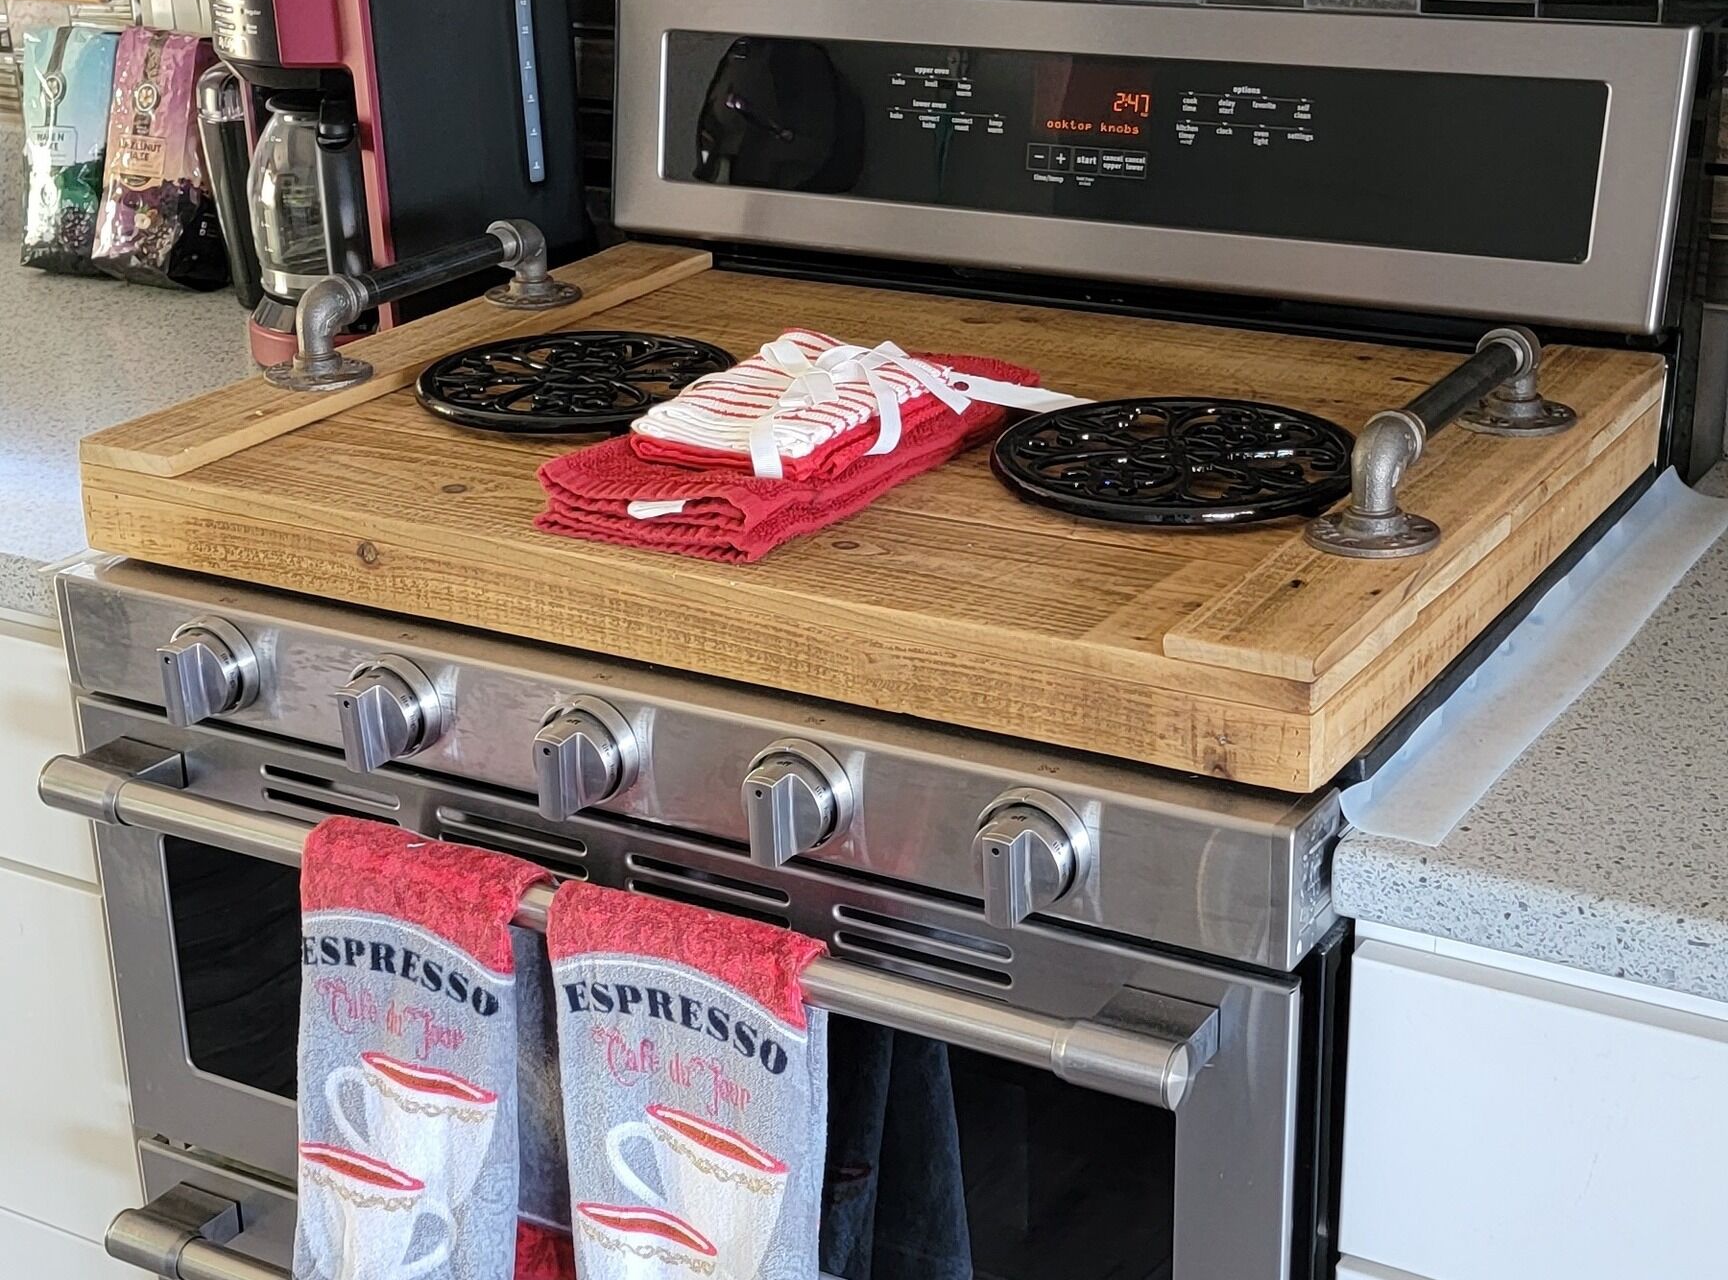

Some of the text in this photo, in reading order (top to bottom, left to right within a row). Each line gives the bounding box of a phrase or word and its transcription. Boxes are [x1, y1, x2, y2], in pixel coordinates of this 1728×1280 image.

[1232, 86, 1261, 95] options
[1100, 122, 1140, 135] knobs
[1076, 155, 1097, 165] start
[302, 936, 499, 1016] ESPRESSO
[563, 981, 788, 1075] ESPRESSO
